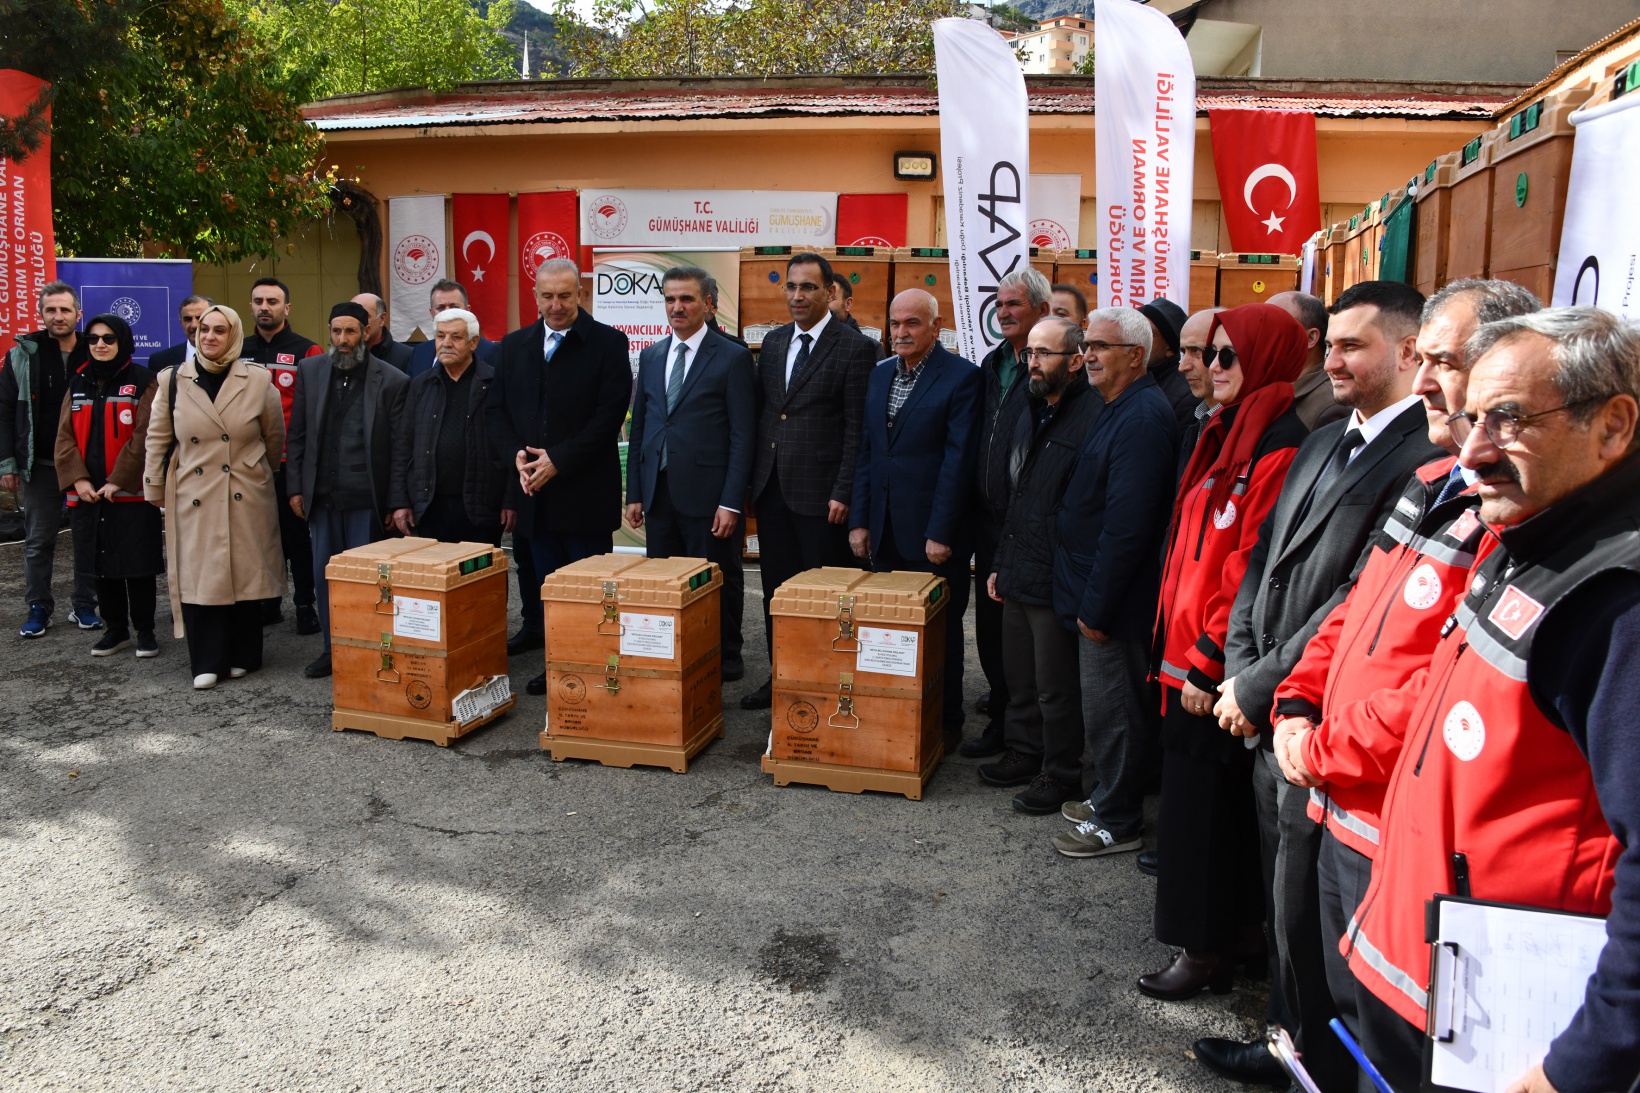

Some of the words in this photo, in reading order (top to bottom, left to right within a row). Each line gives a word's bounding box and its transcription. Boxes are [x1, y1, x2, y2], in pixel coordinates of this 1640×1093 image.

[13, 175, 26, 241] ORMAN
[693, 201, 713, 214] T.C.
[648, 216, 713, 235] GÜMÜŞHANE
[715, 217, 759, 234] VALİLİĞİ
[14, 243, 27, 265] VE
[597, 273, 664, 296] DOKA
[1622, 254, 1636, 307] Projesi
[15, 268, 29, 321] TARIM
[612, 324, 663, 336] YVANCILIK
